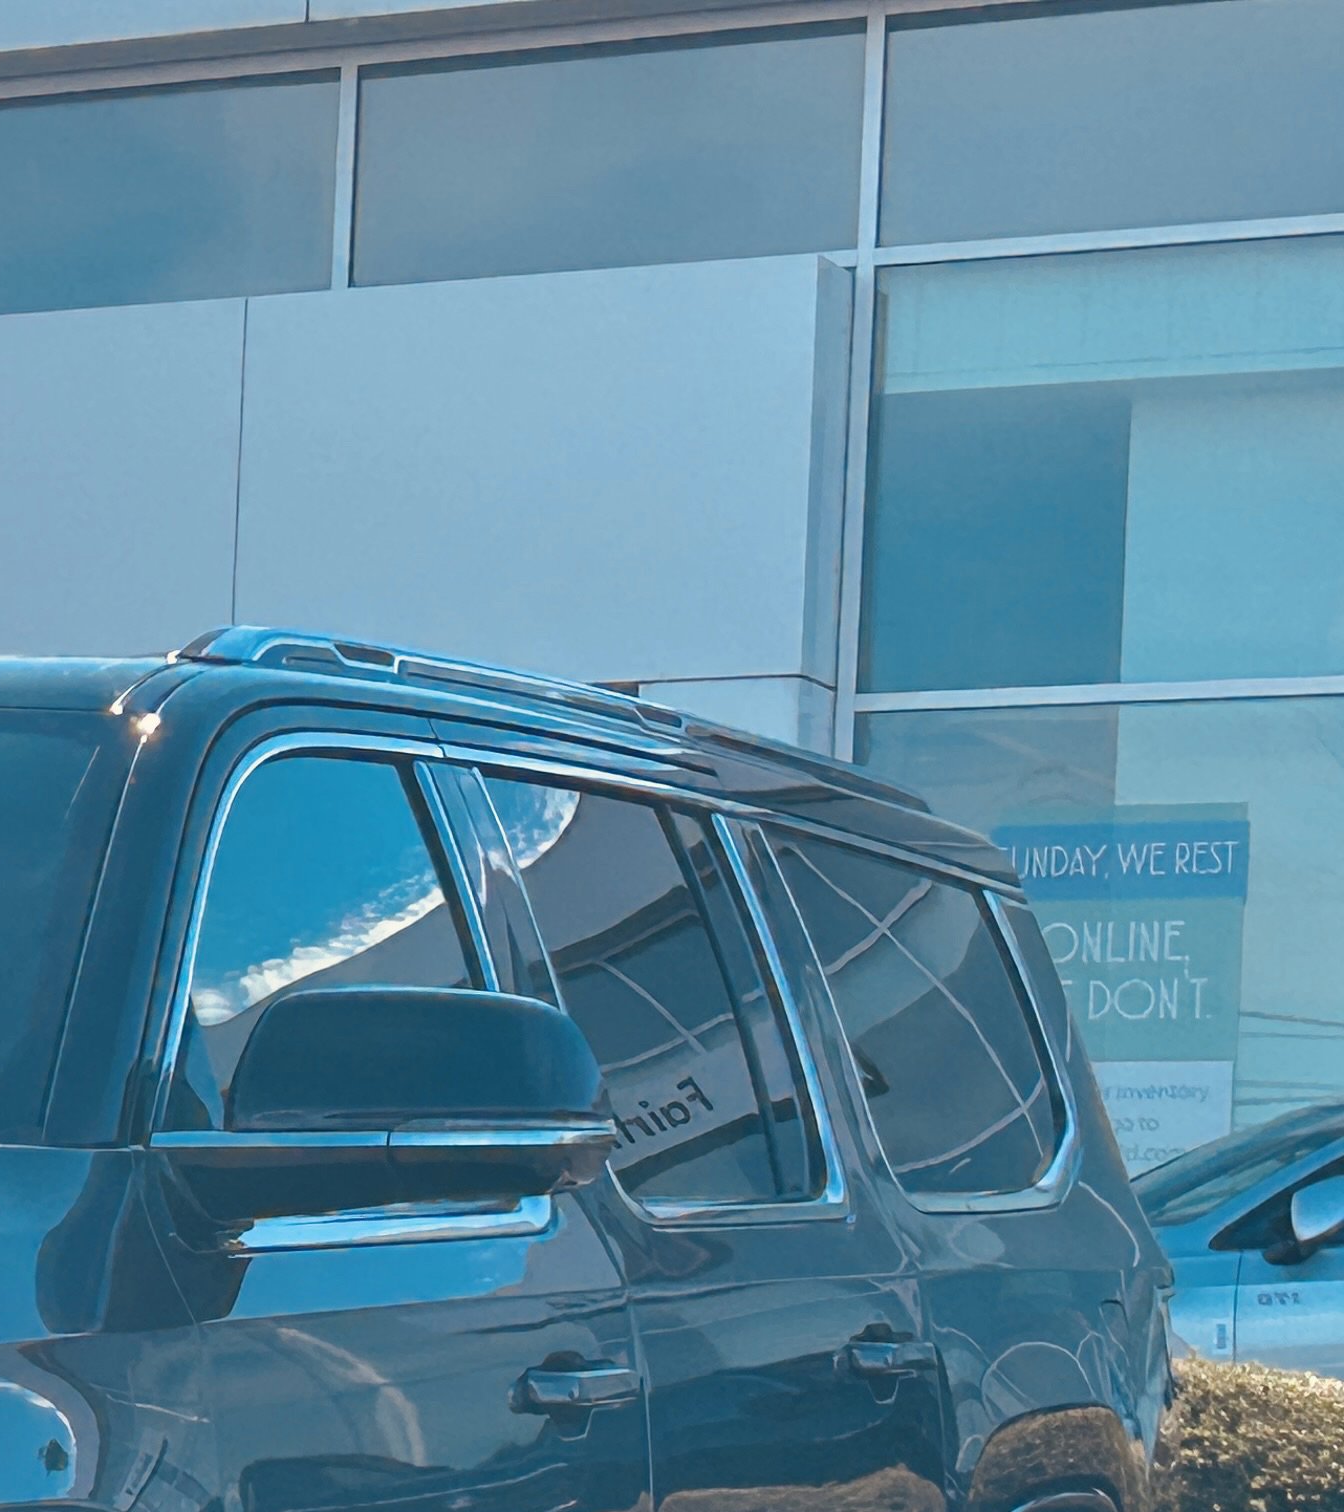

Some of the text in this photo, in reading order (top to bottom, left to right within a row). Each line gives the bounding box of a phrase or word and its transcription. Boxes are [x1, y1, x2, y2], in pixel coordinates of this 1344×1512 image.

[999, 841, 1239, 879] UNDAY, WE REST
